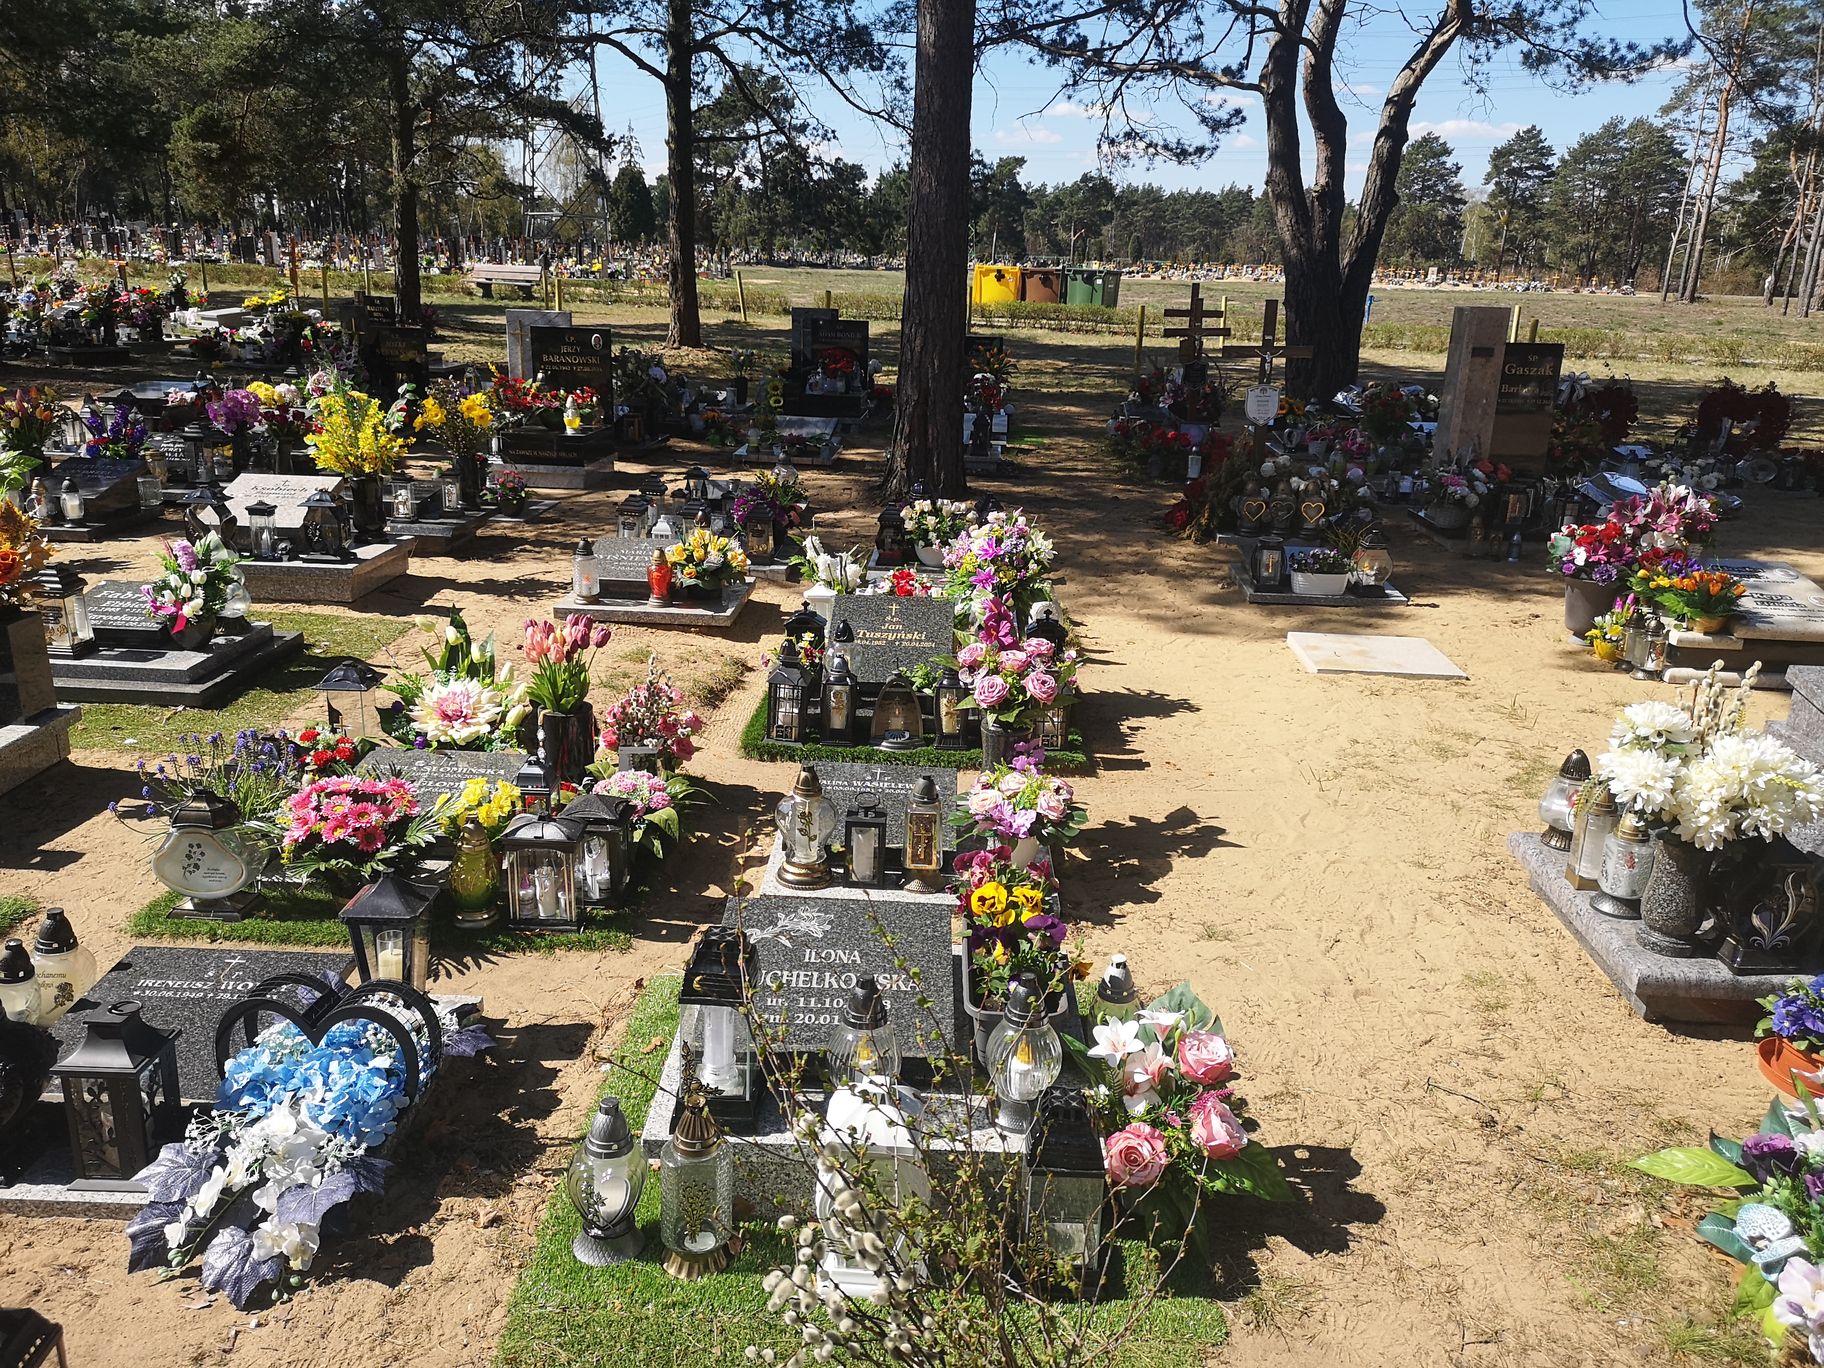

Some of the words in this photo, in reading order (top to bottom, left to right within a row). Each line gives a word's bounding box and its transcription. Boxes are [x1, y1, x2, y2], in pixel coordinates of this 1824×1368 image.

[560, 345, 581, 354] JERZY
[542, 353, 601, 365] BARANOWSKI
[1504, 362, 1554, 376] Gaszak
[1501, 383, 1539, 393] Barba
[594, 554, 654, 562] WIŚNIEW
[880, 623, 903, 631] Jan
[856, 629, 927, 641] Tuszyński
[818, 779, 849, 787] ALINA
[803, 948, 862, 964] ILONA
[136, 979, 217, 990] IRENEUSZ
